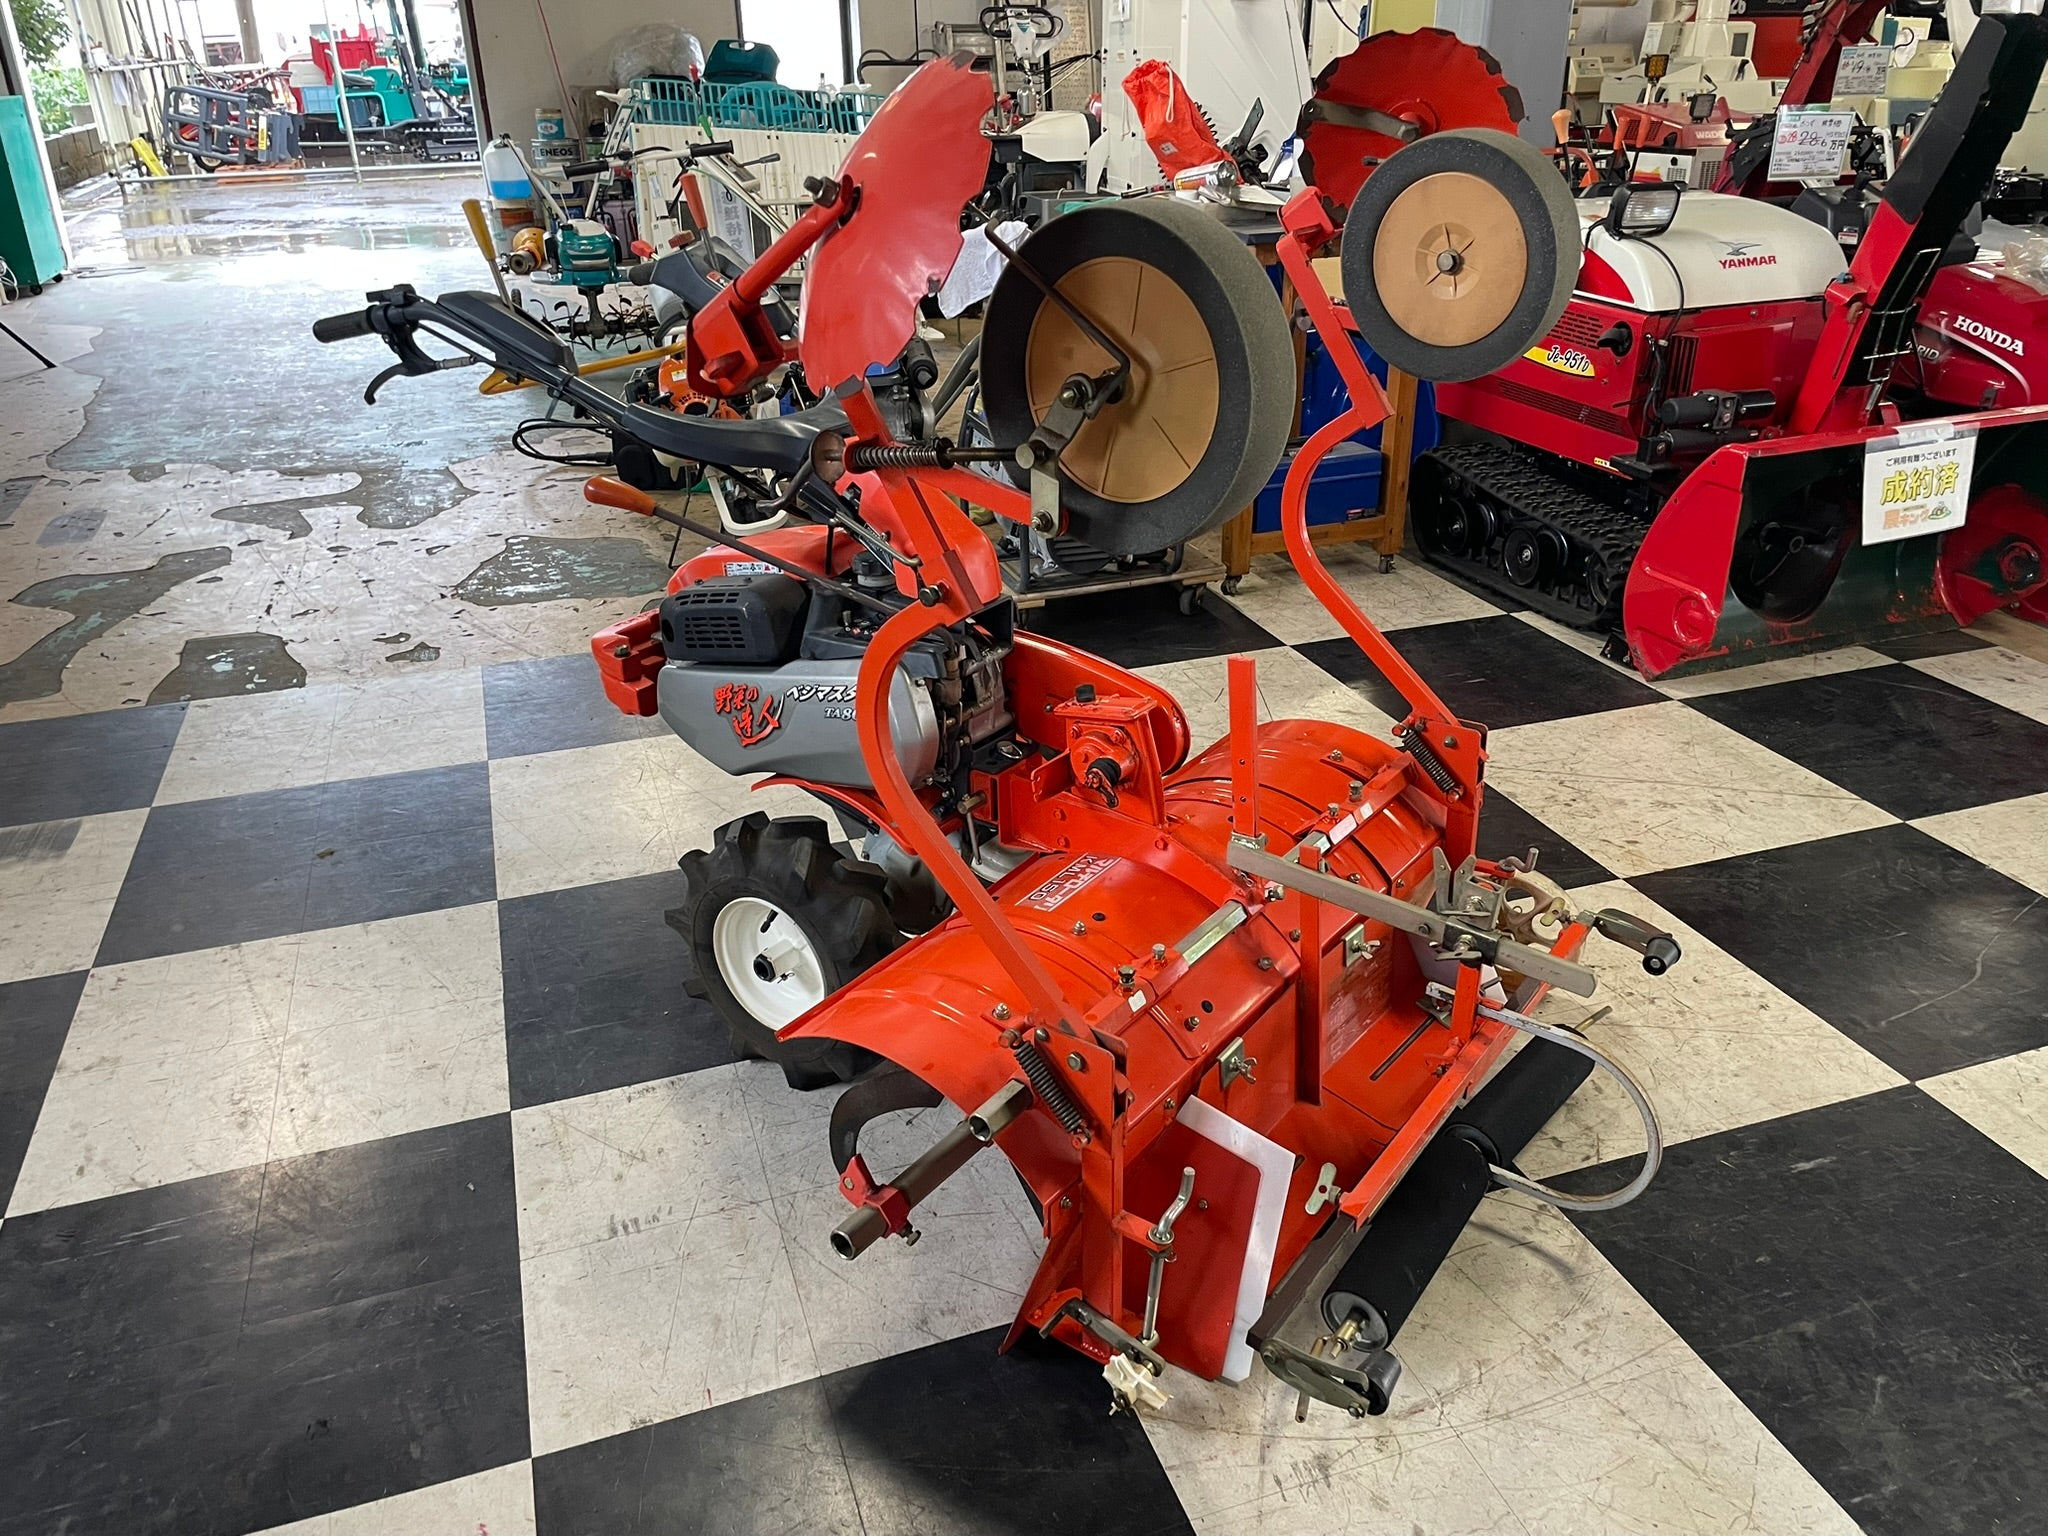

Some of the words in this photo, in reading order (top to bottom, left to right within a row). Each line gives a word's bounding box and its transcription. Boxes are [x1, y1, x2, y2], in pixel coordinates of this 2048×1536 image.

[540, 147, 574, 157] ENEOS
[1718, 255, 1777, 270] YANMAR
[1952, 315, 2025, 357] HONDA
[1880, 461, 1960, 506] 成約済
[1028, 855, 1099, 900] KML150
